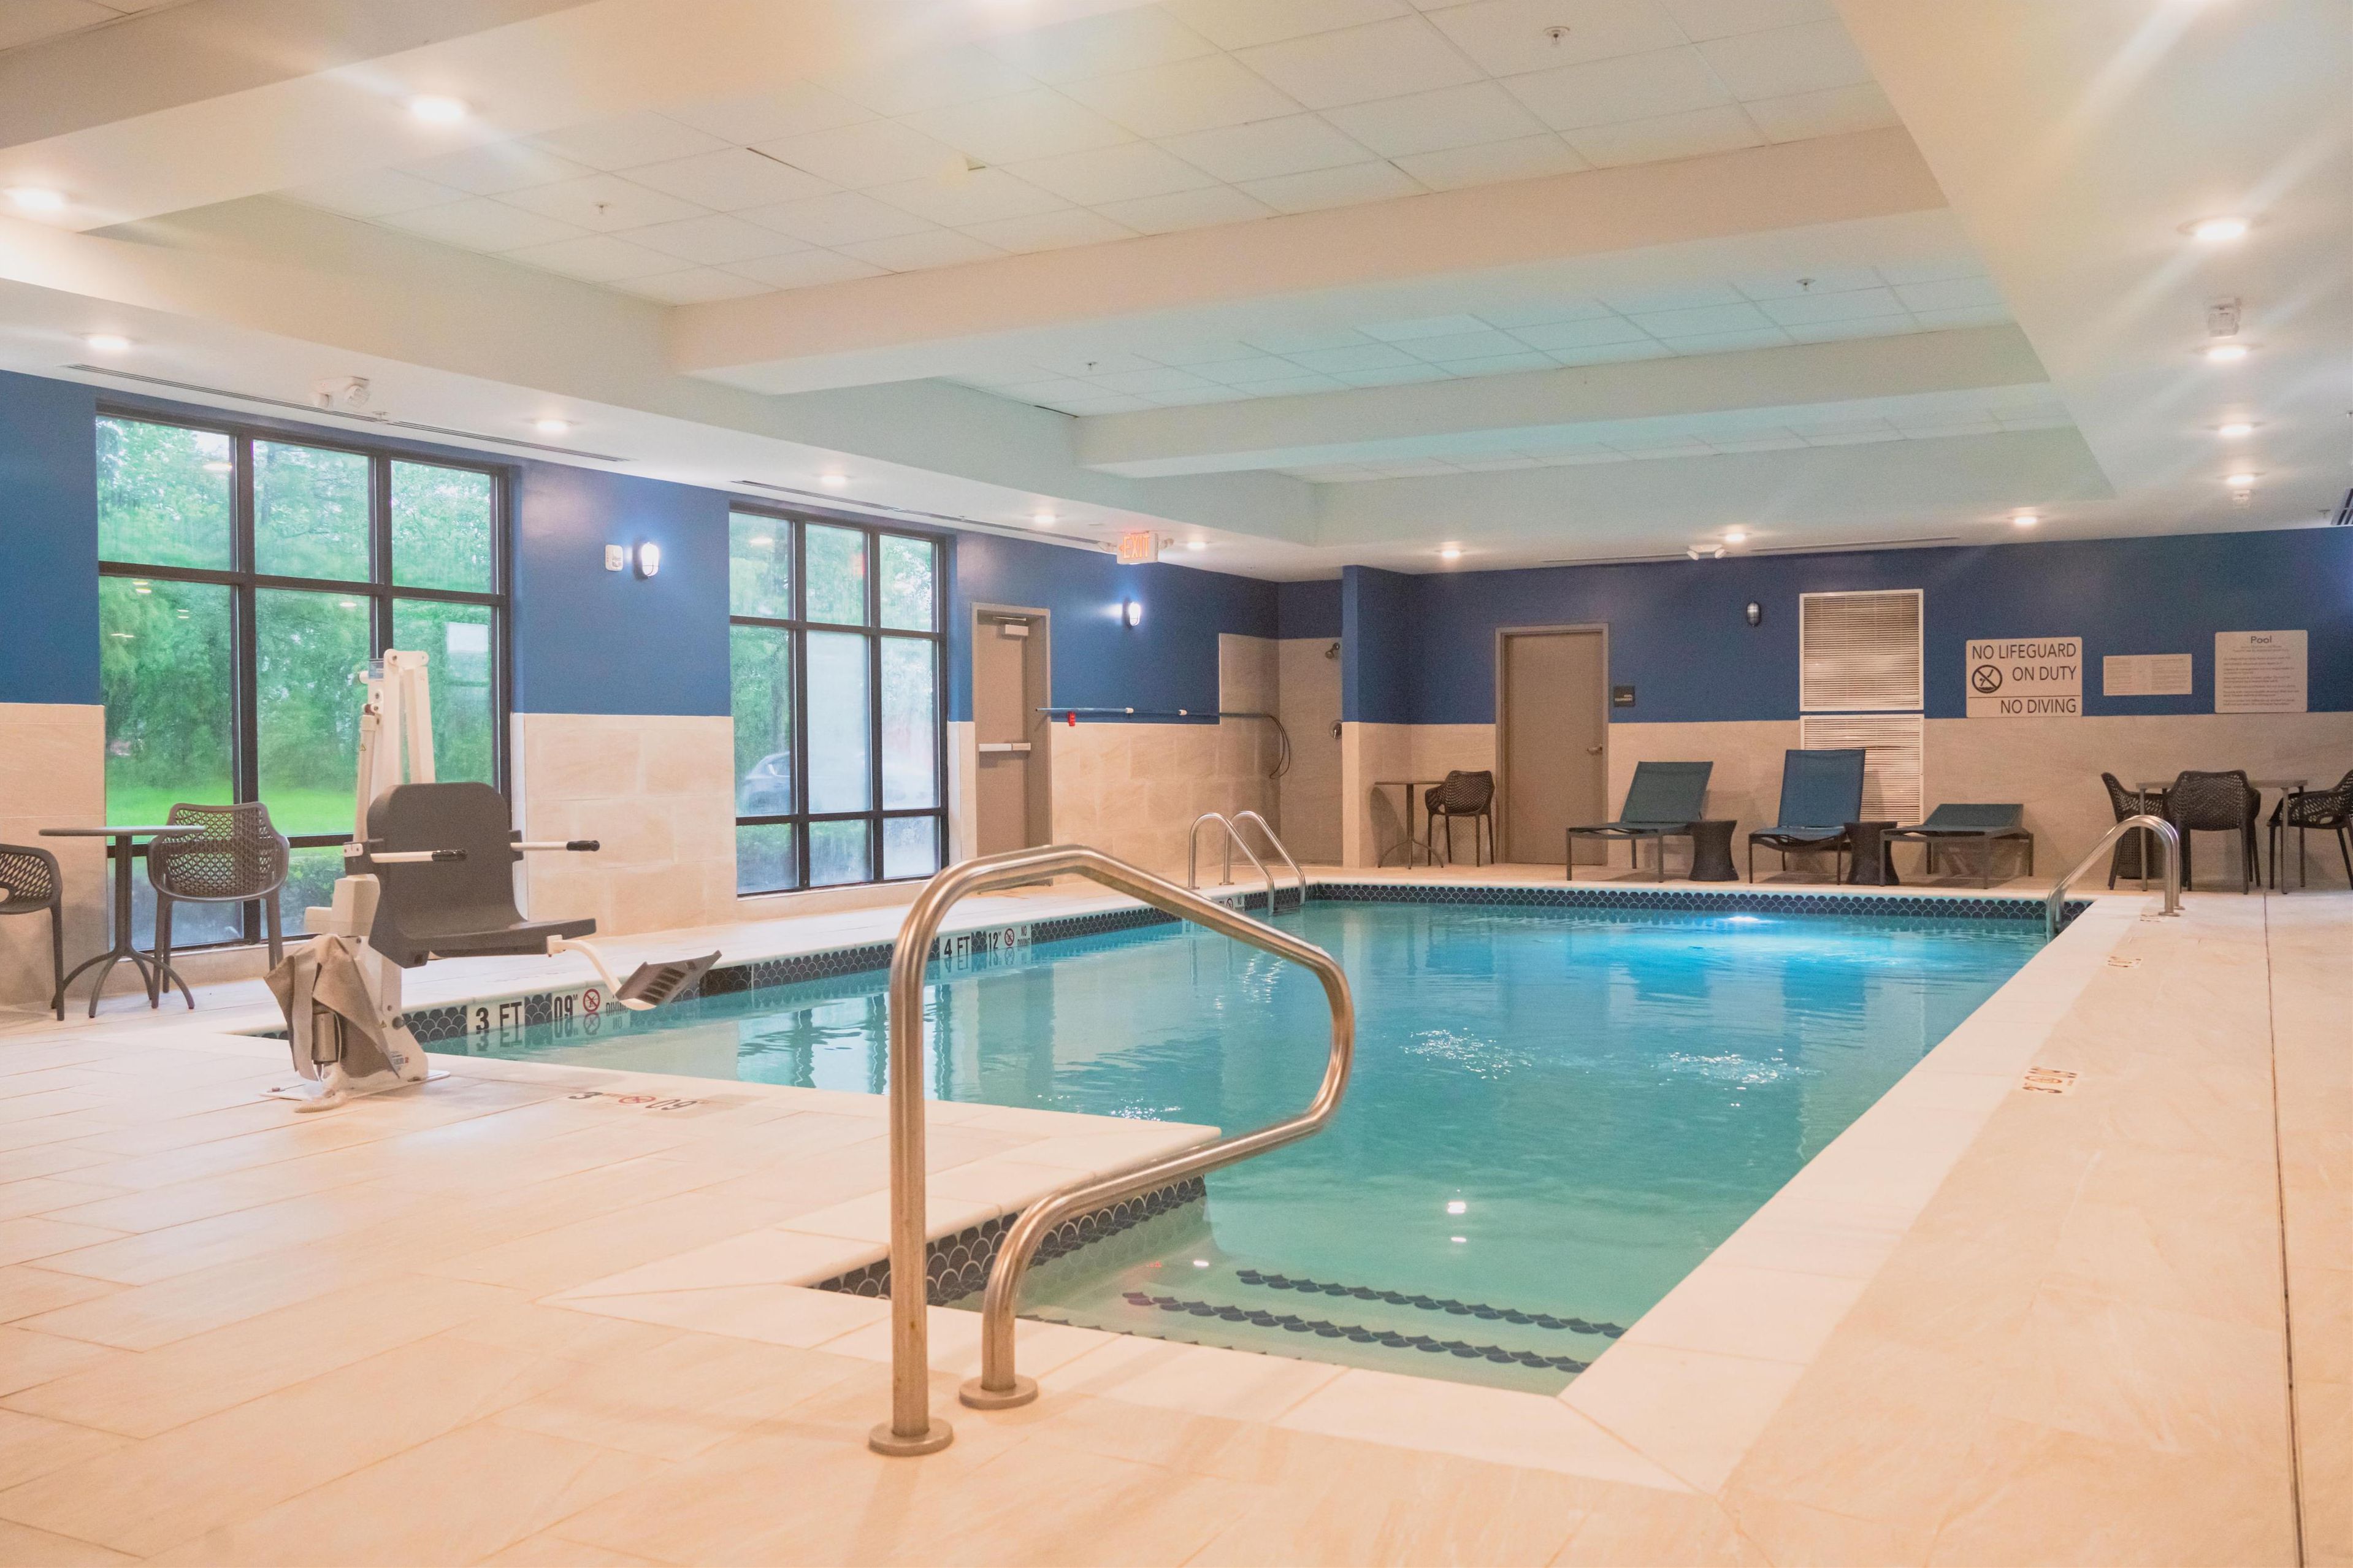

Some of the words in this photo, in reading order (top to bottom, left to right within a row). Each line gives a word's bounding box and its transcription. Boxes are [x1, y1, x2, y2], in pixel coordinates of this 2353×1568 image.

[1123, 534, 1149, 559] EXIT
[2251, 635, 2272, 644] Pool
[1972, 644, 1994, 659] NO
[1999, 643, 2076, 659] LIFEGUARD
[2012, 667, 2035, 681] ON
[2040, 666, 2076, 681] DUTY
[2000, 699, 2023, 714] NO
[2027, 698, 2076, 714] DIVING
[1021, 925, 1027, 936] NO
[944, 938, 952, 956] 4
[957, 936, 970, 955] FT
[475, 1007, 490, 1033] 3
[499, 1001, 522, 1028] FT
